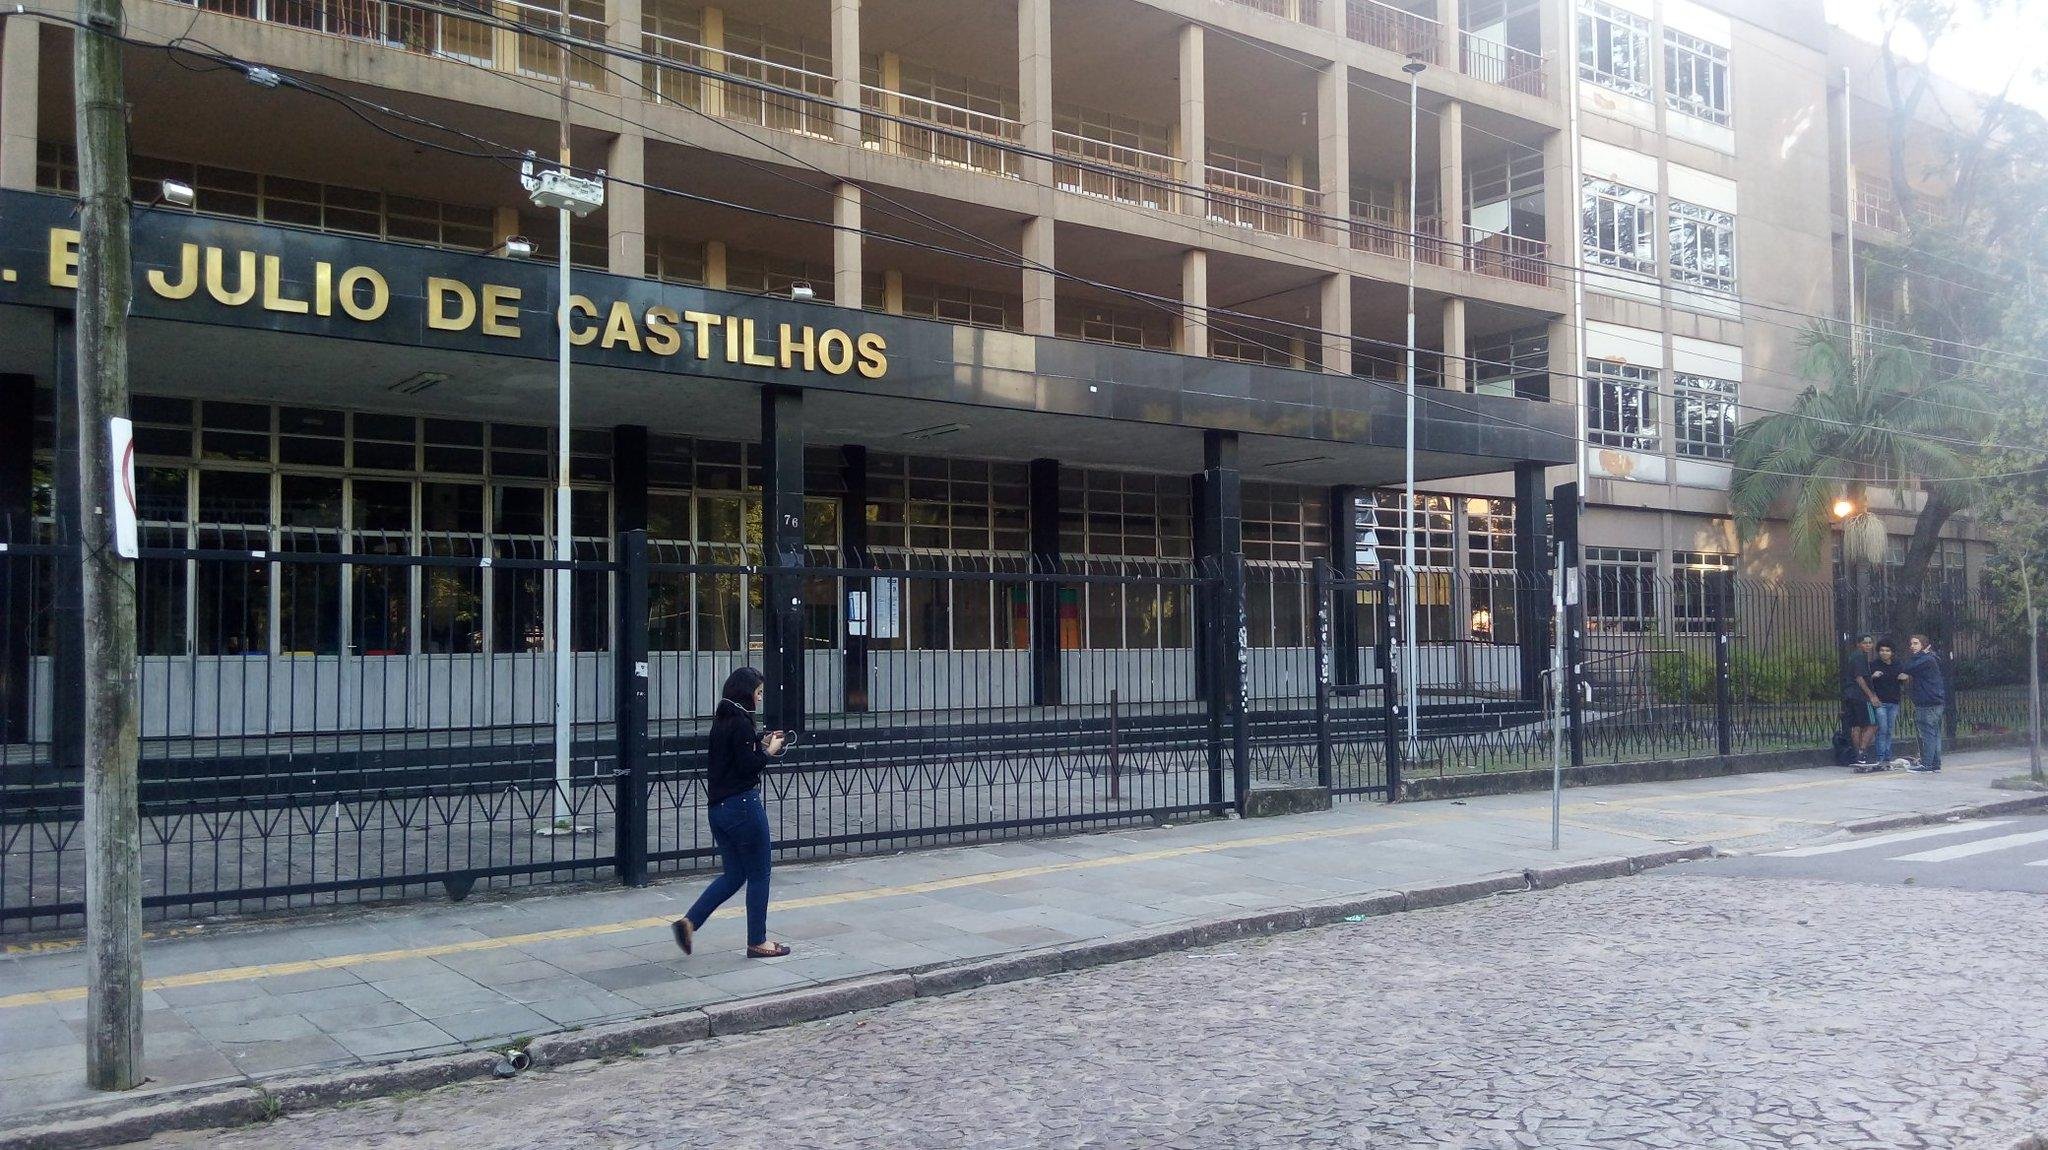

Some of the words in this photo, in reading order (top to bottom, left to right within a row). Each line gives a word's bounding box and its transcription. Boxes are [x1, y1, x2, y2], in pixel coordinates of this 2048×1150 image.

[147, 242, 390, 321] JULIO
[427, 277, 522, 338] DE
[558, 294, 888, 379] CASTILHOS
